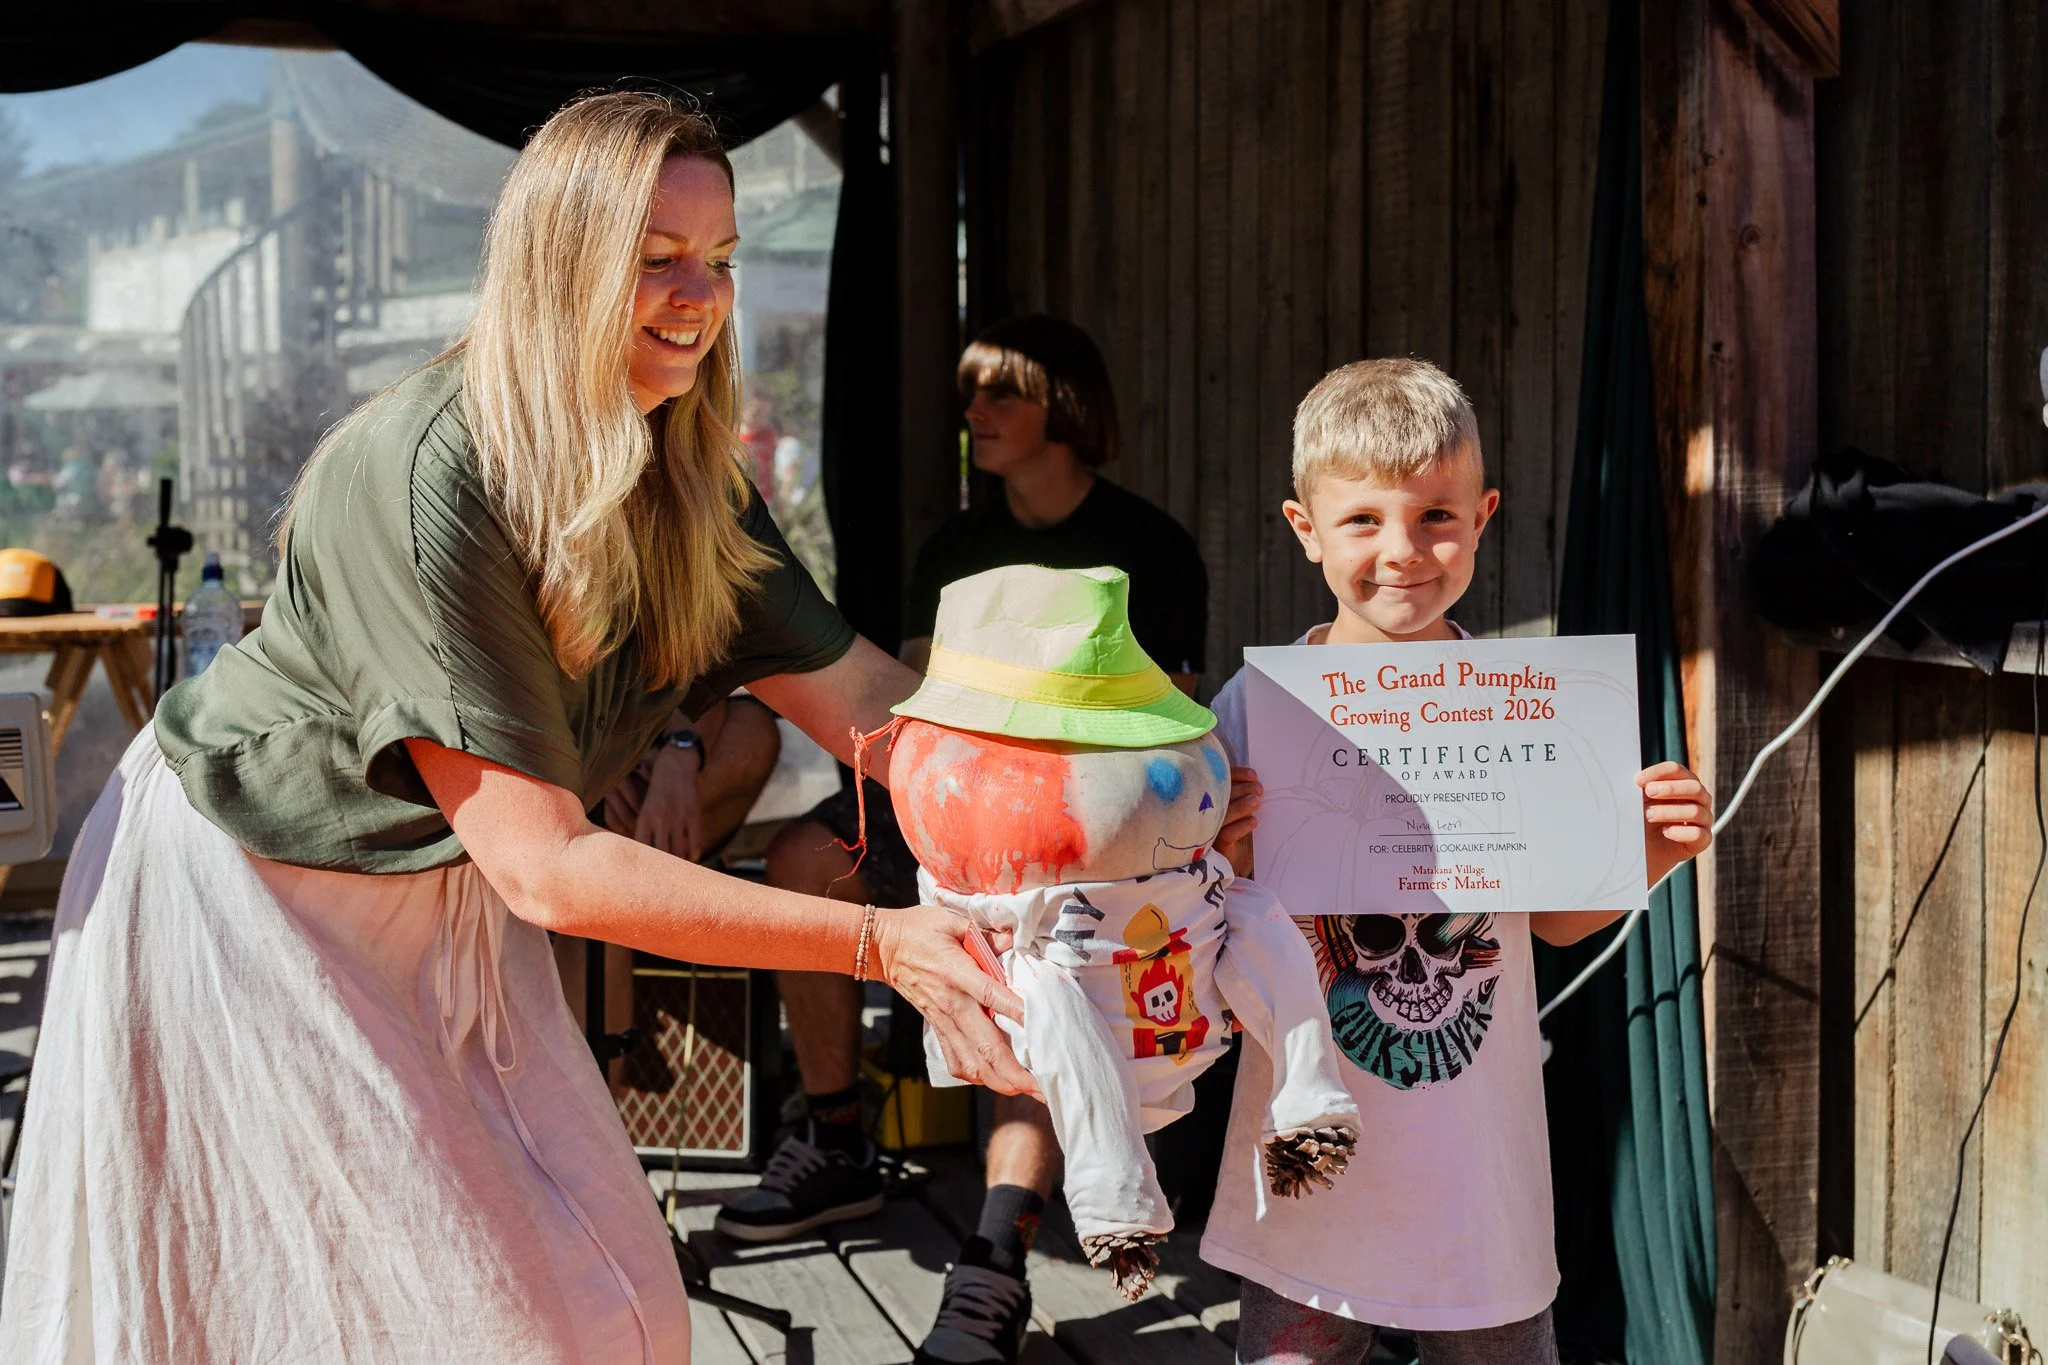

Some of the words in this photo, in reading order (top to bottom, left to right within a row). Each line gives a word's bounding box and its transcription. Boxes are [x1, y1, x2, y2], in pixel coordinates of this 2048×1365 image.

[1321, 671, 1367, 698] The
[1377, 662, 1446, 691] Grand
[1457, 661, 1557, 697] Pumpkin
[1329, 704, 1411, 733] Growing
[1420, 701, 1494, 724] Contest
[1504, 697, 1555, 721] 2026
[1332, 743, 1557, 768] CERTIFICATE
[1401, 771, 1421, 781] OF
[1433, 769, 1488, 780] AWARD
[1385, 793, 1431, 804] PROUDLY
[1433, 792, 1489, 803] PRESENTED
[1491, 791, 1506, 802] TO
[1369, 845, 1390, 854] FOR:
[1391, 844, 1434, 854] CELEBRITY
[1436, 843, 1485, 853] LOOKALIKE
[1487, 842, 1527, 852] PUMPKIN
[1413, 865, 1452, 875] Matakana
[1455, 864, 1485, 877] Village
[1454, 875, 1501, 890] Market
[1330, 1000, 1493, 1088] QUIKSILVER
